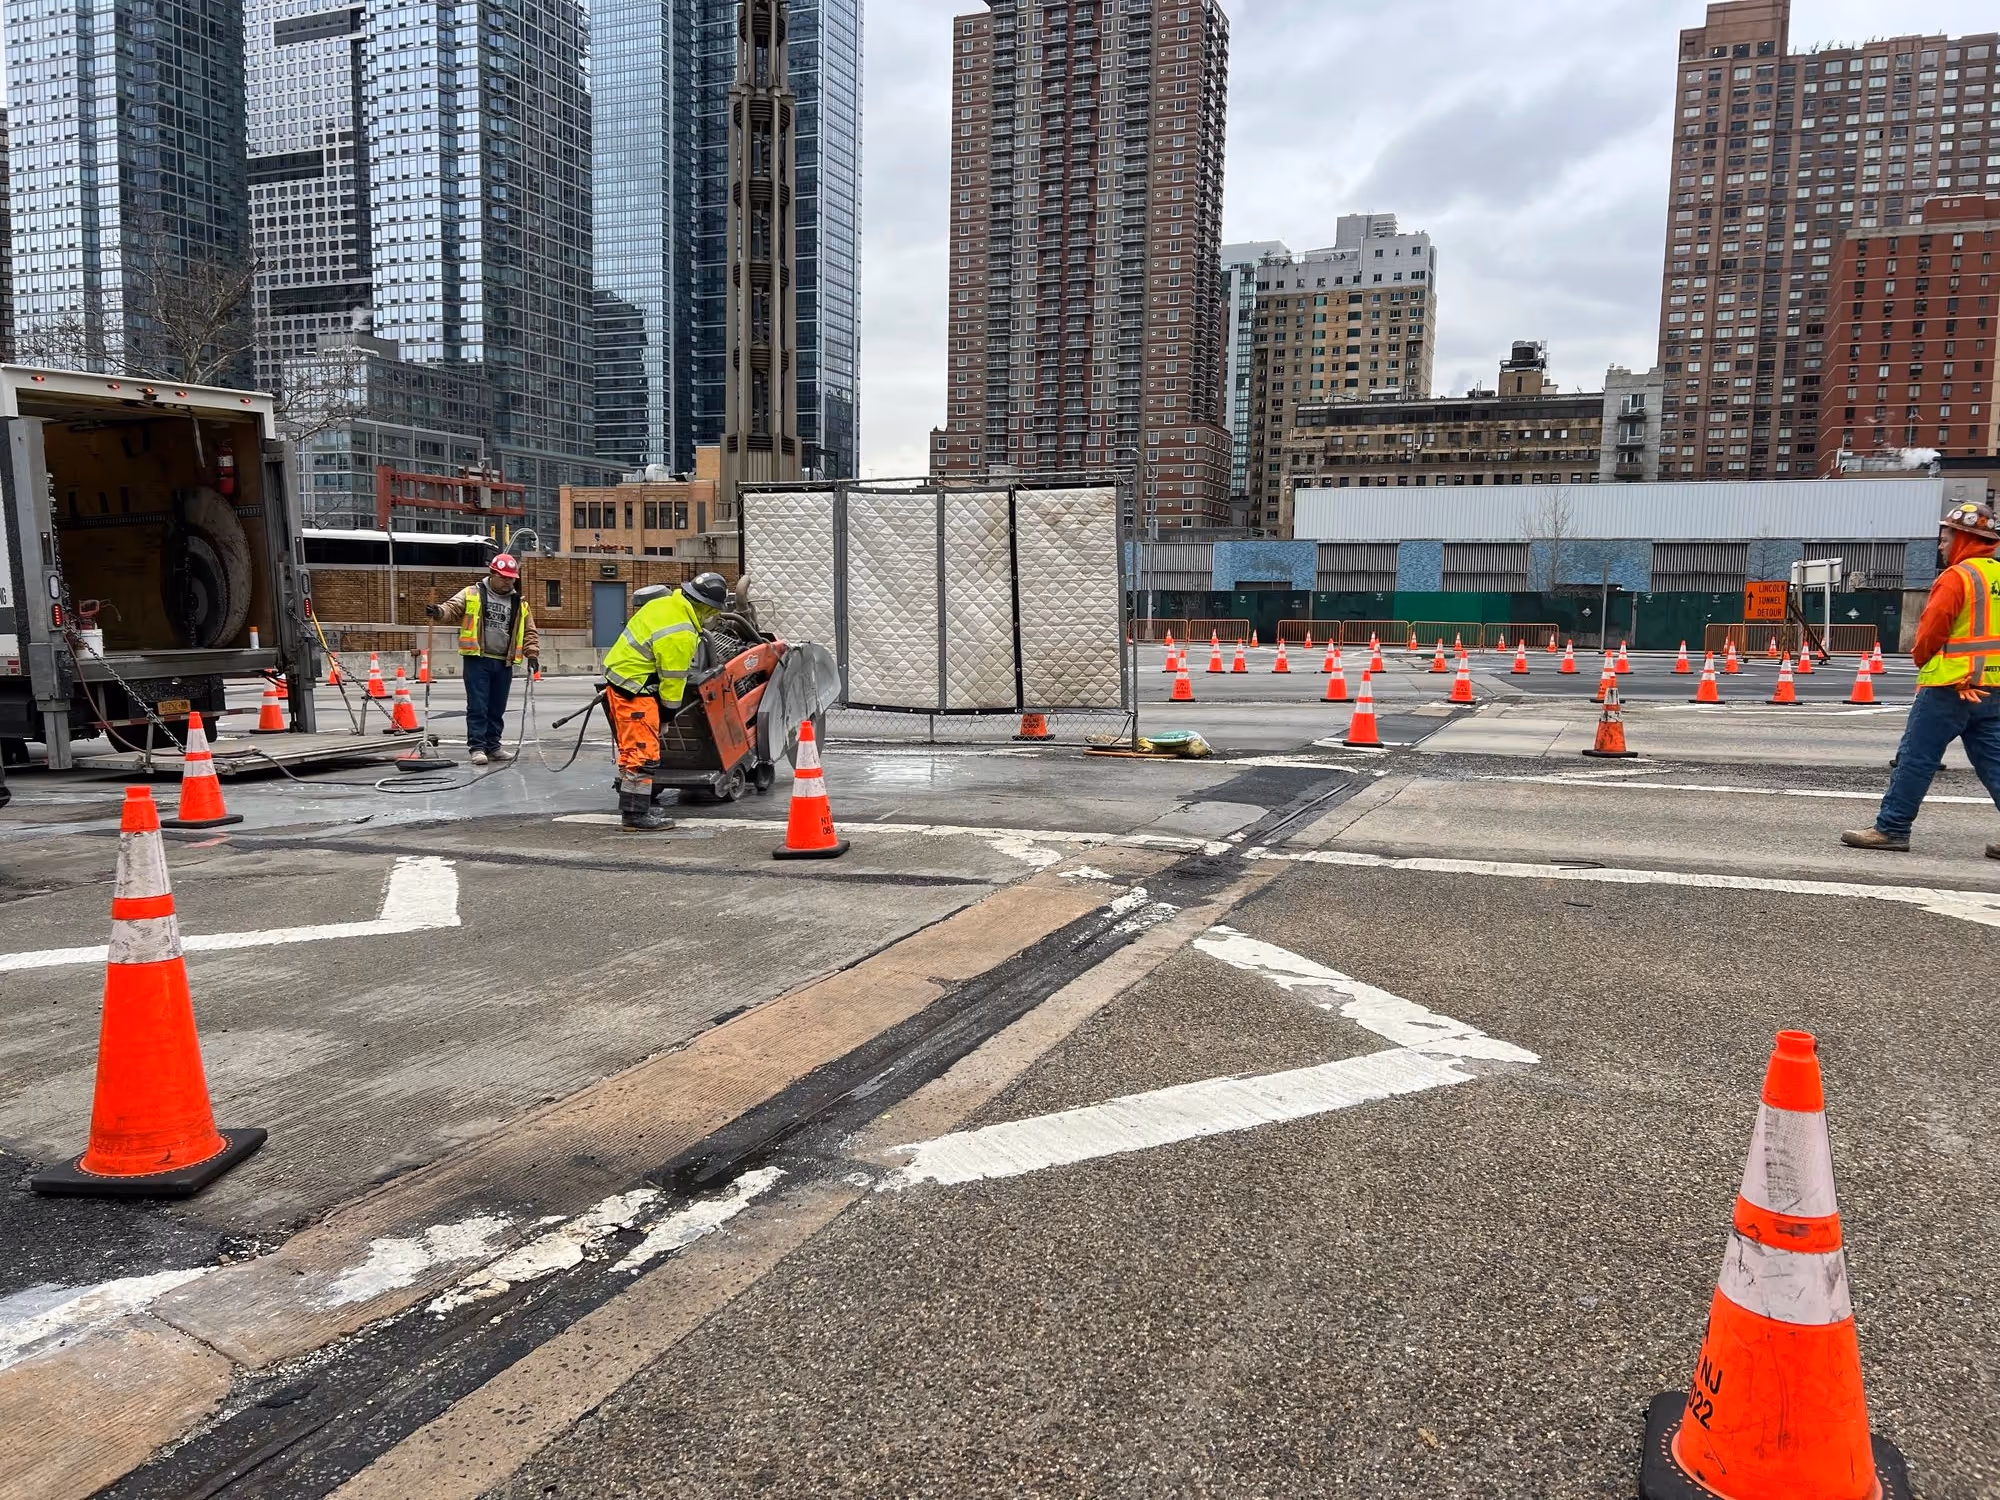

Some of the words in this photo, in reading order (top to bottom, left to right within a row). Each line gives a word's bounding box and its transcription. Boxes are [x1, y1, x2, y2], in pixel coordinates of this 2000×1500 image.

[1758, 584, 1785, 593] LINCOLN
[1758, 596, 1782, 605] TUNNEL
[1757, 608, 1782, 617] DETOUR
[1700, 1355, 1723, 1395] NJ
